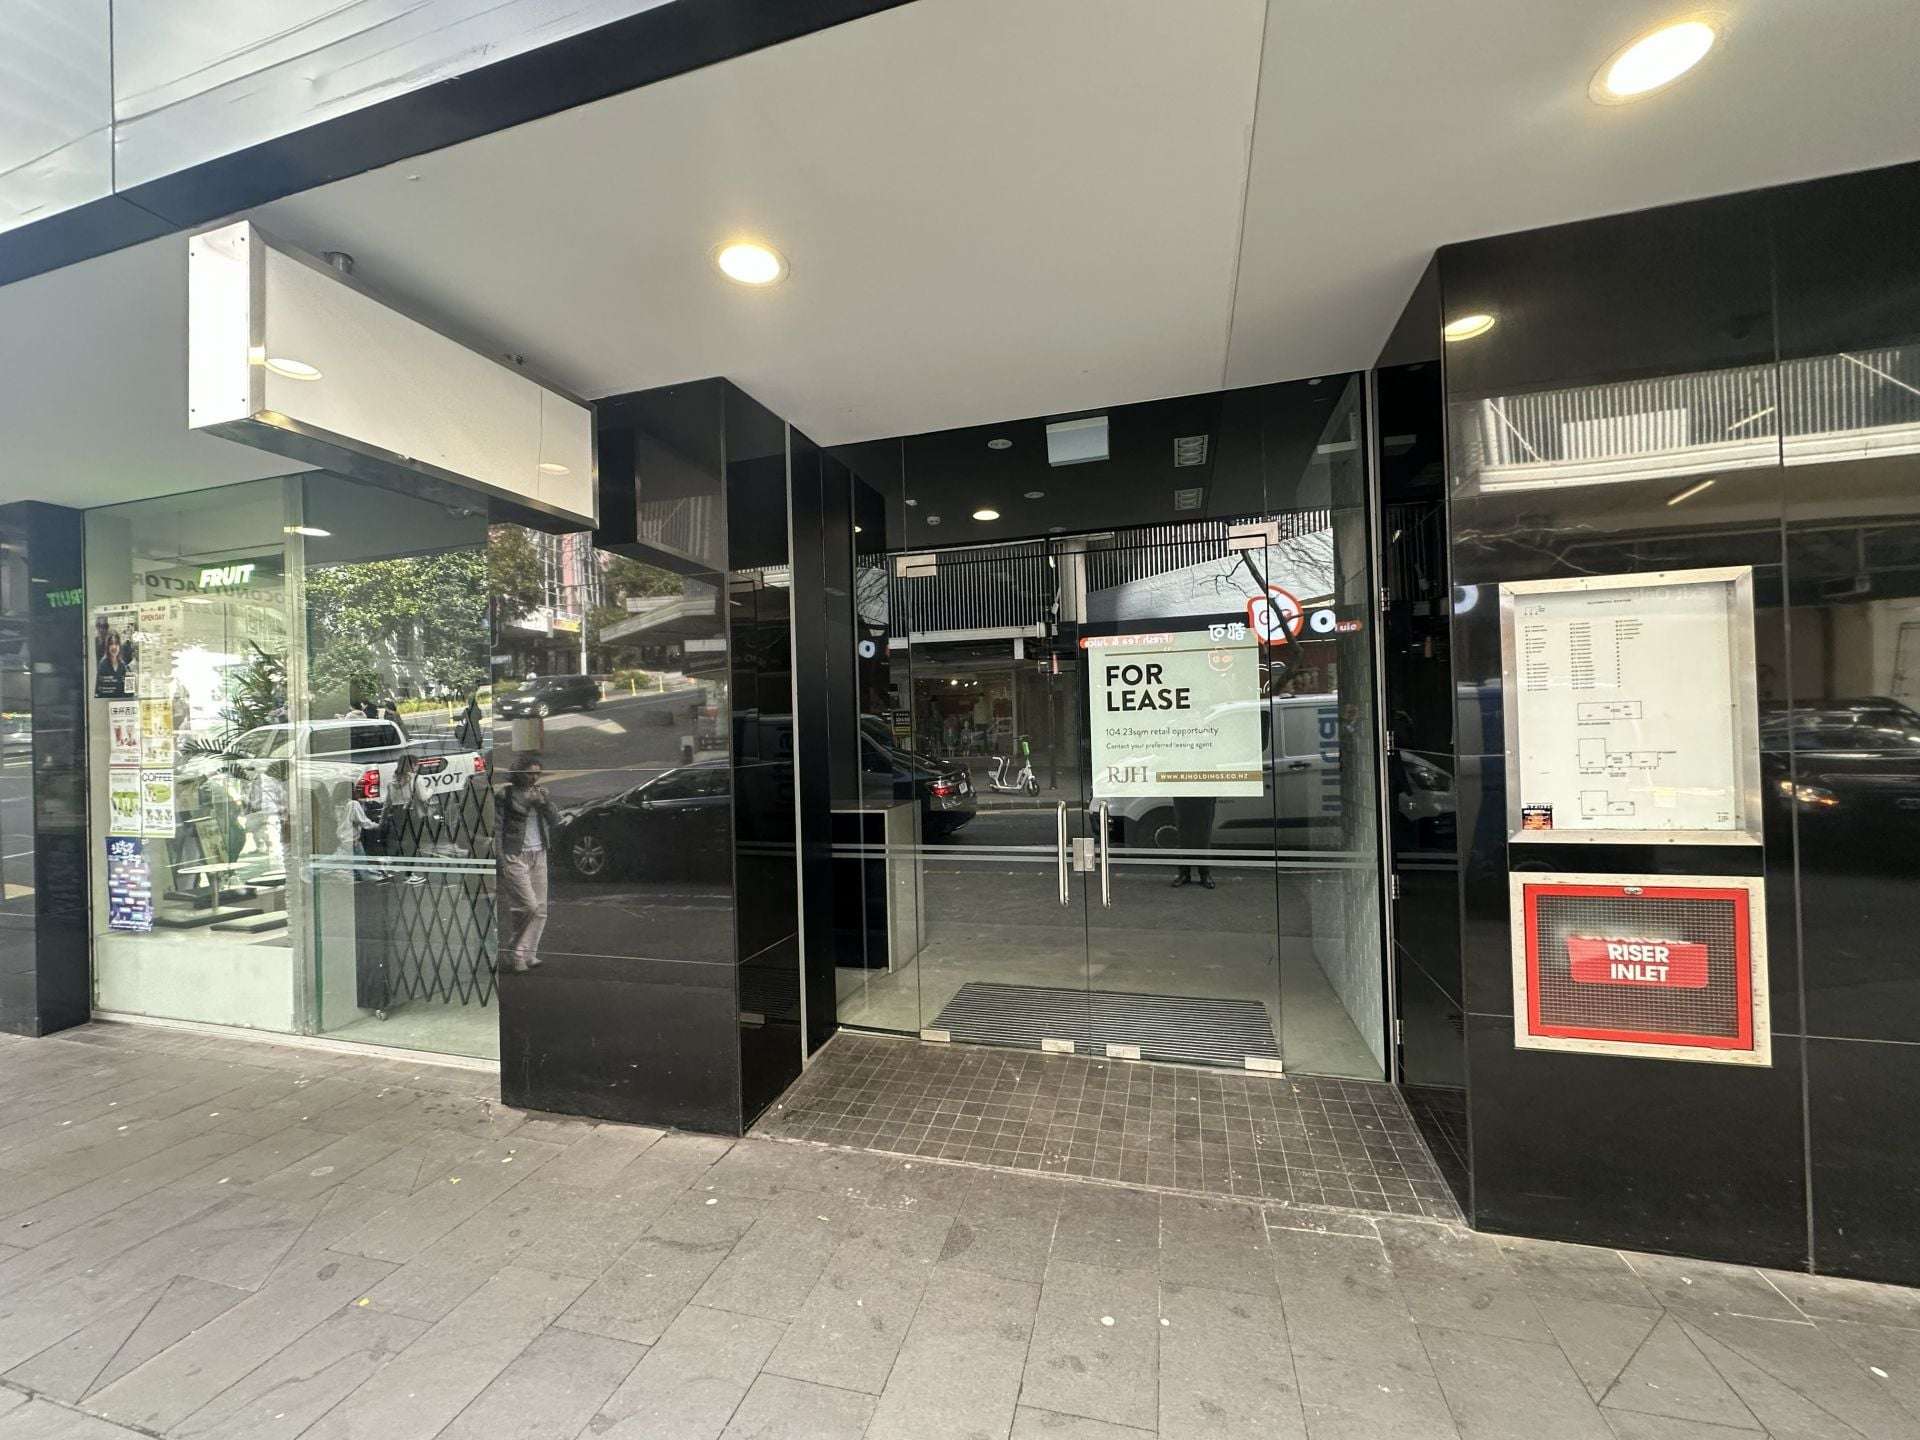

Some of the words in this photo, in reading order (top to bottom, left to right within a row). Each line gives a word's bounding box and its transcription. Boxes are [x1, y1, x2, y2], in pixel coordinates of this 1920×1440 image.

[200, 563, 255, 588] FRUIT
[1106, 664, 1163, 687] FOR
[1107, 688, 1191, 712] LEASE
[1150, 727, 1171, 736] retail
[1172, 726, 1220, 737] opportunity
[1106, 742, 1130, 750] Contact
[1131, 743, 1144, 751] your
[1145, 741, 1173, 751] preferred
[1174, 741, 1194, 750] leasing
[1195, 741, 1213, 750] agent
[1106, 766, 1149, 784] RJH
[1607, 943, 1670, 963] RISER
[1610, 963, 1669, 982] INLET
